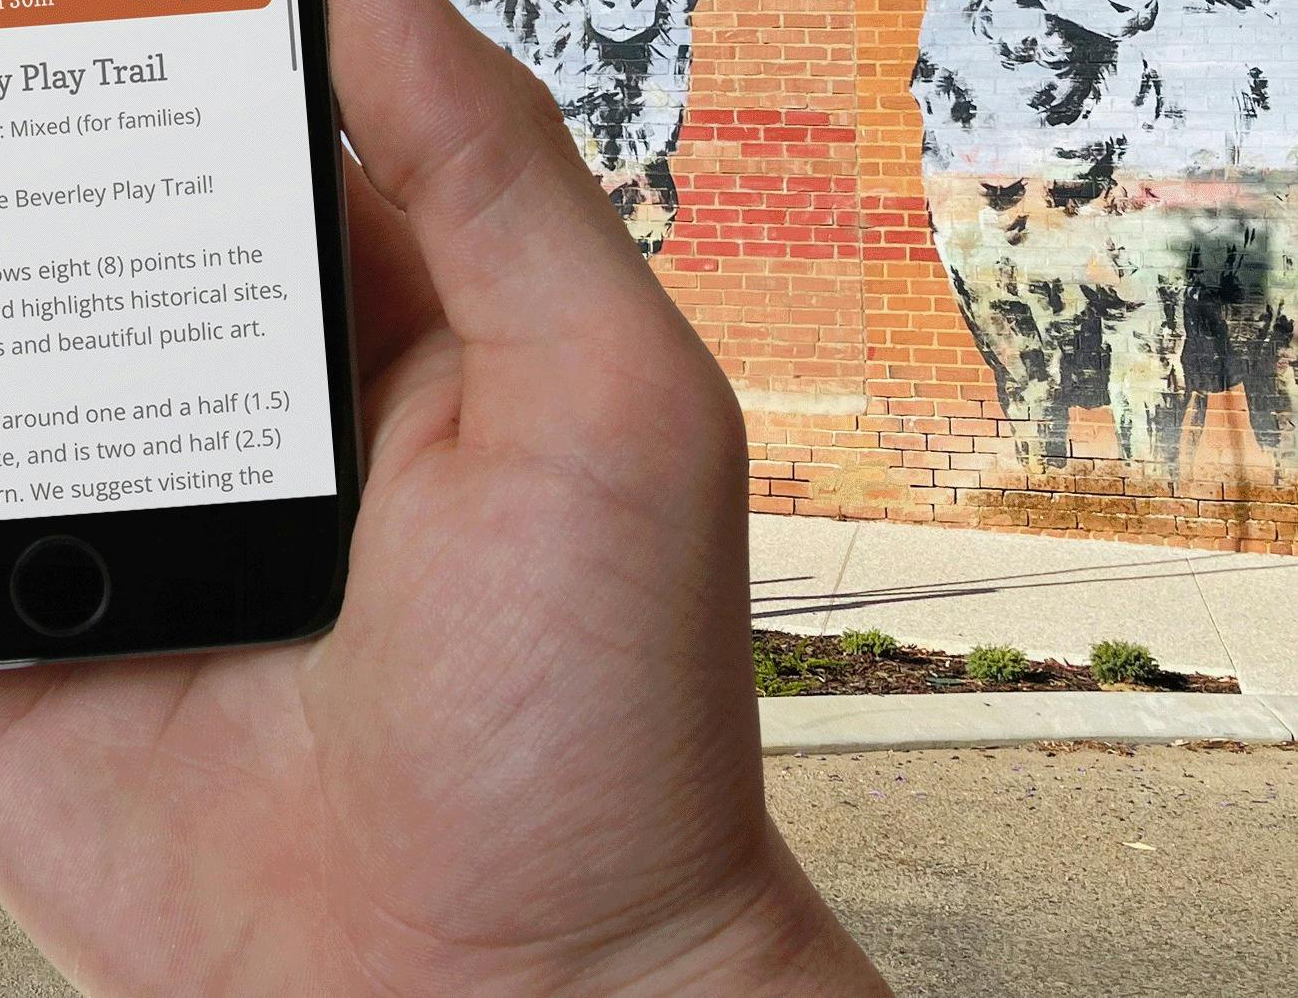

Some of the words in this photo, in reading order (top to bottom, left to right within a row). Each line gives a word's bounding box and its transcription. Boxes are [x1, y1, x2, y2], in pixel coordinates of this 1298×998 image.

[19, 61, 86, 95] Play
[92, 53, 168, 86] Trail
[10, 115, 70, 137] Mixed
[76, 113, 112, 136] (for
[117, 106, 201, 129] families)
[15, 184, 106, 208] Beverley
[112, 180, 156, 204] Play
[160, 174, 213, 196] Trail!
[38, 258, 91, 283] eight
[97, 255, 124, 278] (8)
[130, 252, 196, 278] points
[202, 248, 222, 267] in
[227, 245, 263, 265] the
[21, 293, 125, 321] highlights
[130, 283, 227, 309] historical
[233, 282, 287, 302] sites,
[11, 333, 51, 355] and
[58, 325, 152, 352] beautiful
[159, 321, 223, 349] public
[230, 320, 265, 339] art.
[2, 404, 79, 429] around
[85, 406, 126, 423] one
[132, 397, 172, 420] and
[179, 401, 191, 416] a
[198, 393, 239, 415] half
[244, 390, 290, 415] (1.5)
[27, 442, 67, 465] and
[74, 442, 90, 461] is
[96, 442, 136, 459] two
[142, 434, 182, 456] and
[189, 430, 229, 452] half
[235, 427, 281, 452] (2.5)
[29, 482, 64, 501] We
[70, 476, 153, 502] suggest
[157, 469, 234, 493] visiting
[239, 466, 274, 485] the
